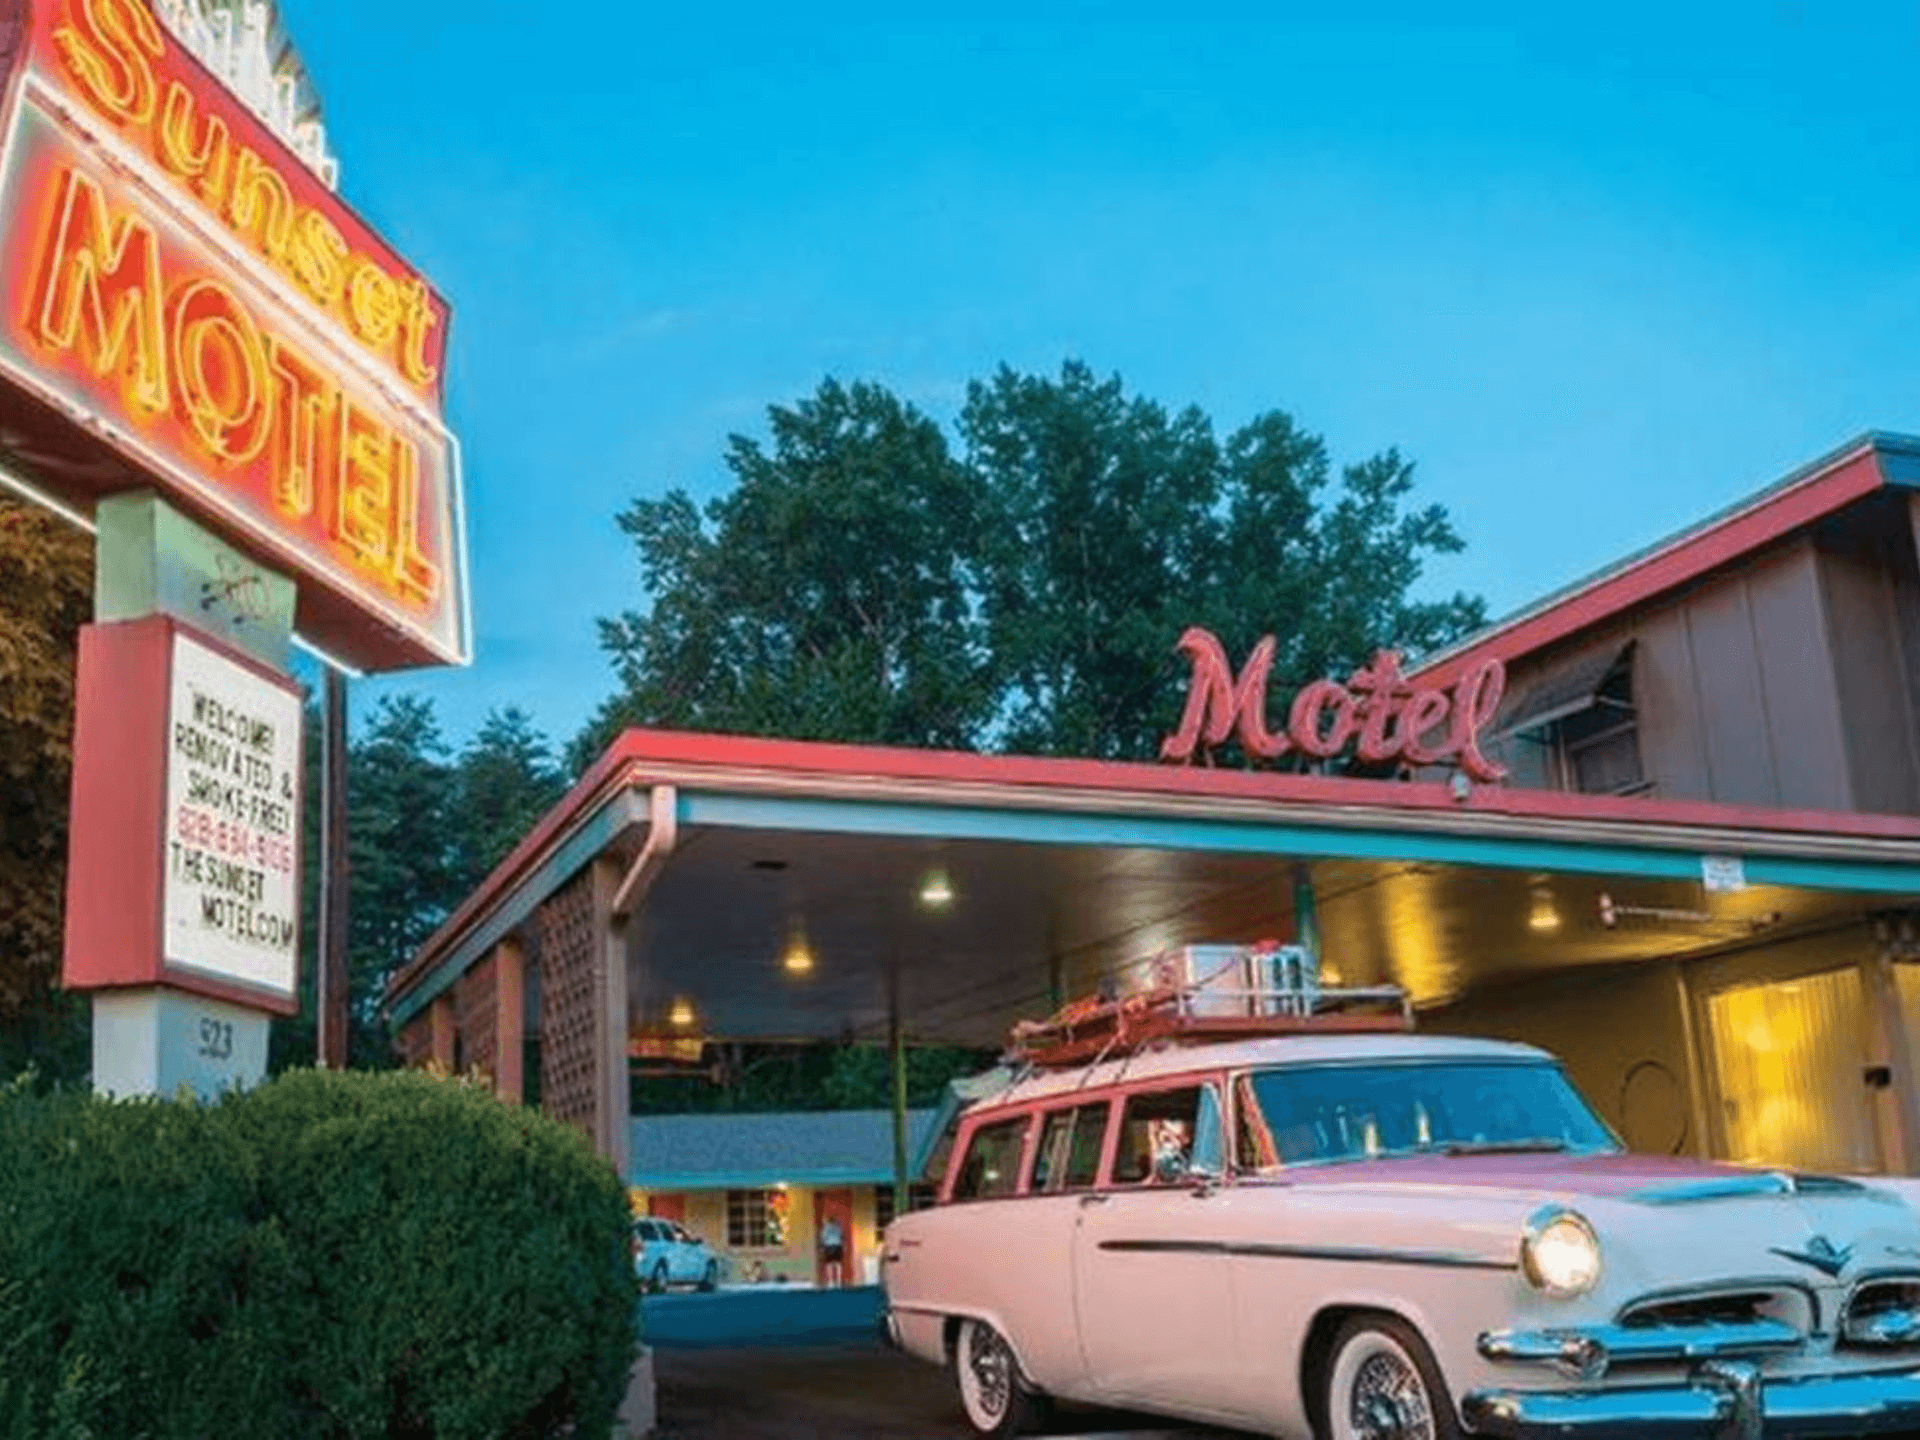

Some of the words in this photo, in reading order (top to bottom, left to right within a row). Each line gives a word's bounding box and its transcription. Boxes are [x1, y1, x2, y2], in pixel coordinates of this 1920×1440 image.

[24, 165, 443, 606] MOTEL
[50, 0, 437, 386] Sunset
[1159, 625, 1510, 782] Motel
